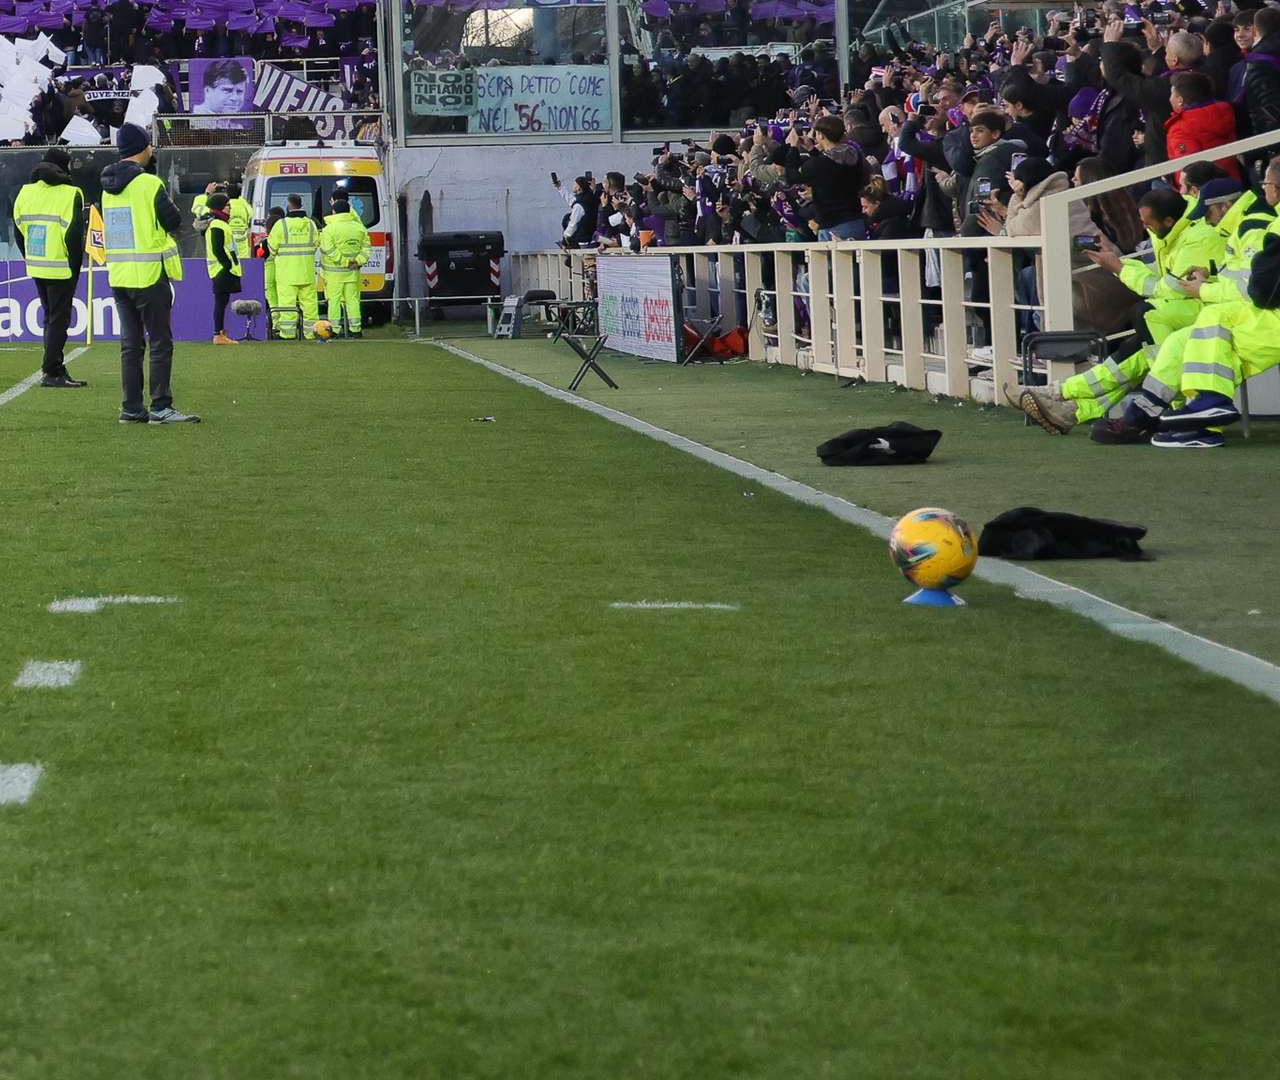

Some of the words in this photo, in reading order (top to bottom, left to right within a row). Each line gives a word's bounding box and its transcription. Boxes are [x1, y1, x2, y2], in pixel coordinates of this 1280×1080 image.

[414, 84, 474, 95] TIFIAMO
[520, 75, 561, 94] DETTO
[478, 107, 515, 132] NEL
